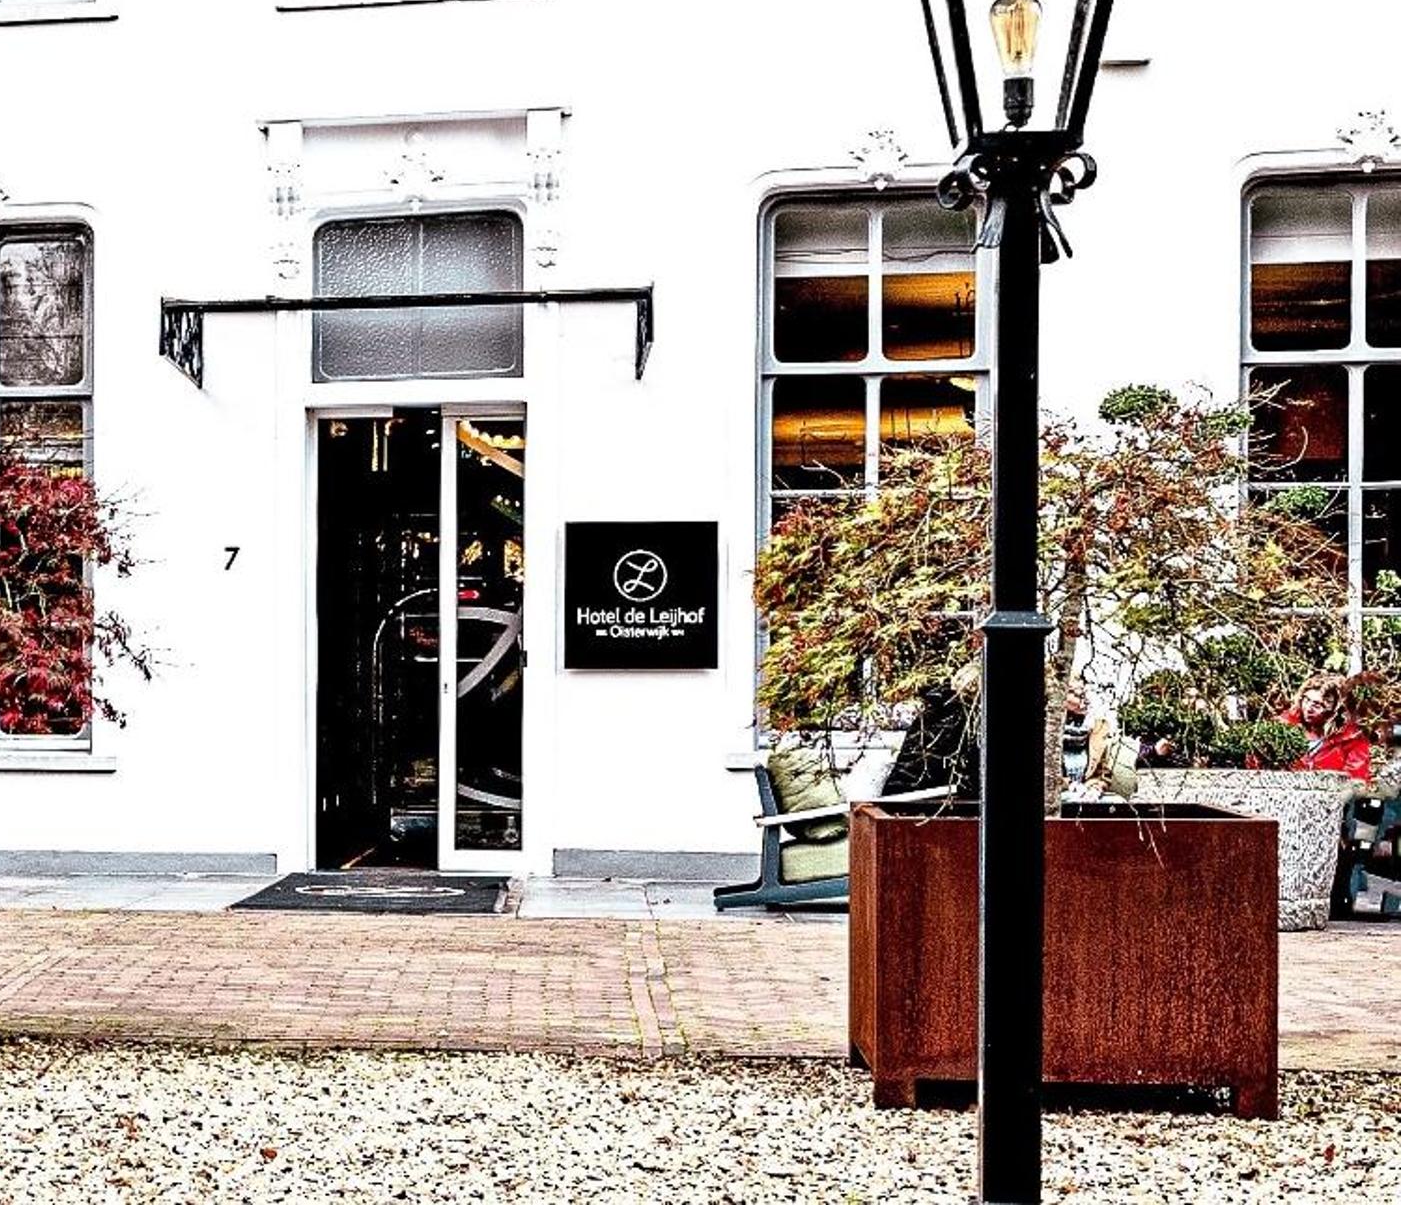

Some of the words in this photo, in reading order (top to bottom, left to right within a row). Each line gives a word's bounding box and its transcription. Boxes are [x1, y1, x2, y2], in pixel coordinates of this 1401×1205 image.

[224, 546, 241, 571] 7
[577, 607, 620, 625] Hotel
[624, 607, 645, 624] de
[650, 607, 705, 627] Leijhof
